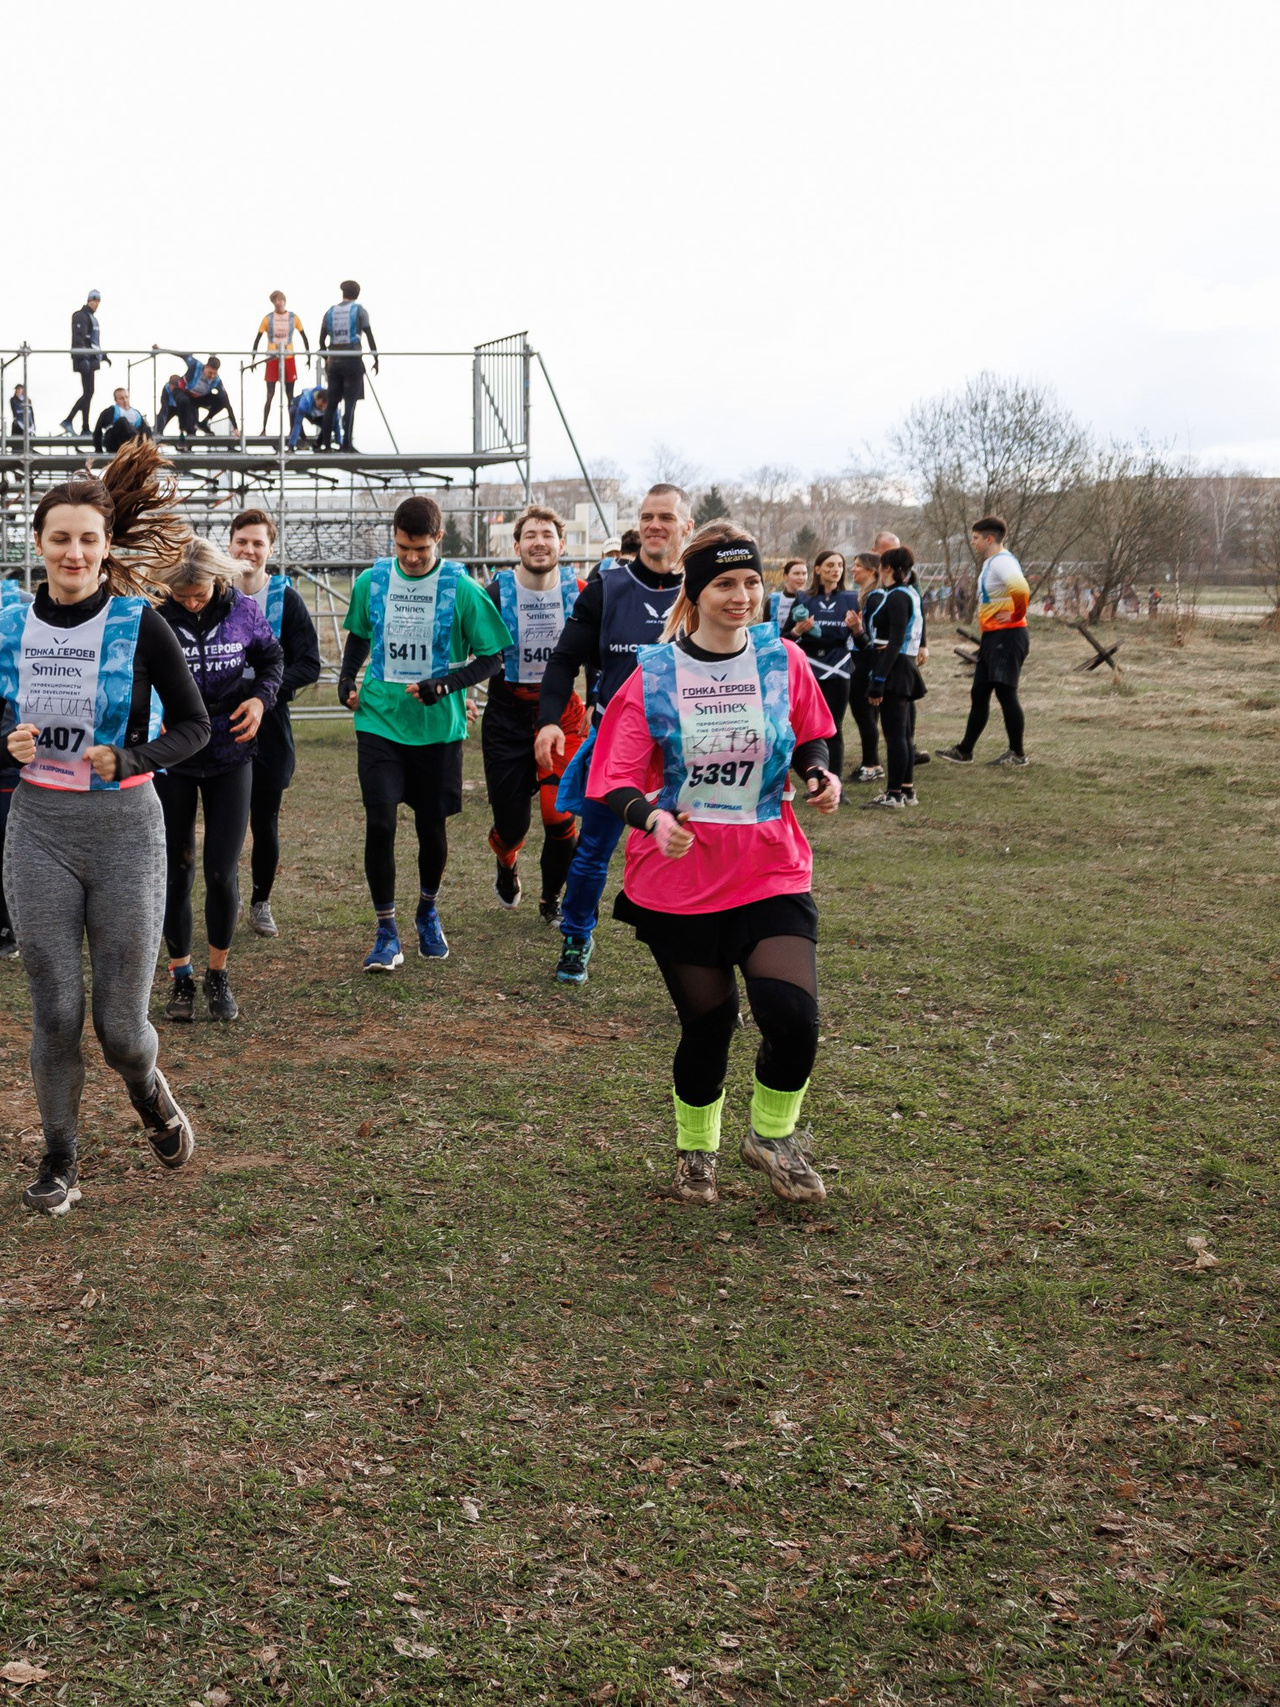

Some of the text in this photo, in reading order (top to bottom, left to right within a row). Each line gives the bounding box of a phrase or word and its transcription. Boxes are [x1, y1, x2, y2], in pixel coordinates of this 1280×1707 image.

[717, 548, 750, 557] Sminex
[395, 603, 425, 613] Sminex
[526, 612, 555, 621] Sminex
[25, 648, 96, 659] ГОНКА ГЕРОЕВ
[182, 642, 243, 657] КА ГЕРОЕВ
[389, 643, 427, 661] 5411
[523, 647, 554, 663] 540
[609, 643, 638, 653] ИНС
[32, 663, 83, 678] Sminex
[682, 684, 756, 696] ГОНКА ГЕРОЕВ
[24, 695, 95, 718] МАША
[695, 701, 748, 716] Sminex
[33, 726, 86, 753] 407
[39, 764, 75, 777] ГАЗПРОМБАНК
[688, 760, 755, 788] 5397
[703, 802, 743, 811] ГАЗПРОМБАНК
